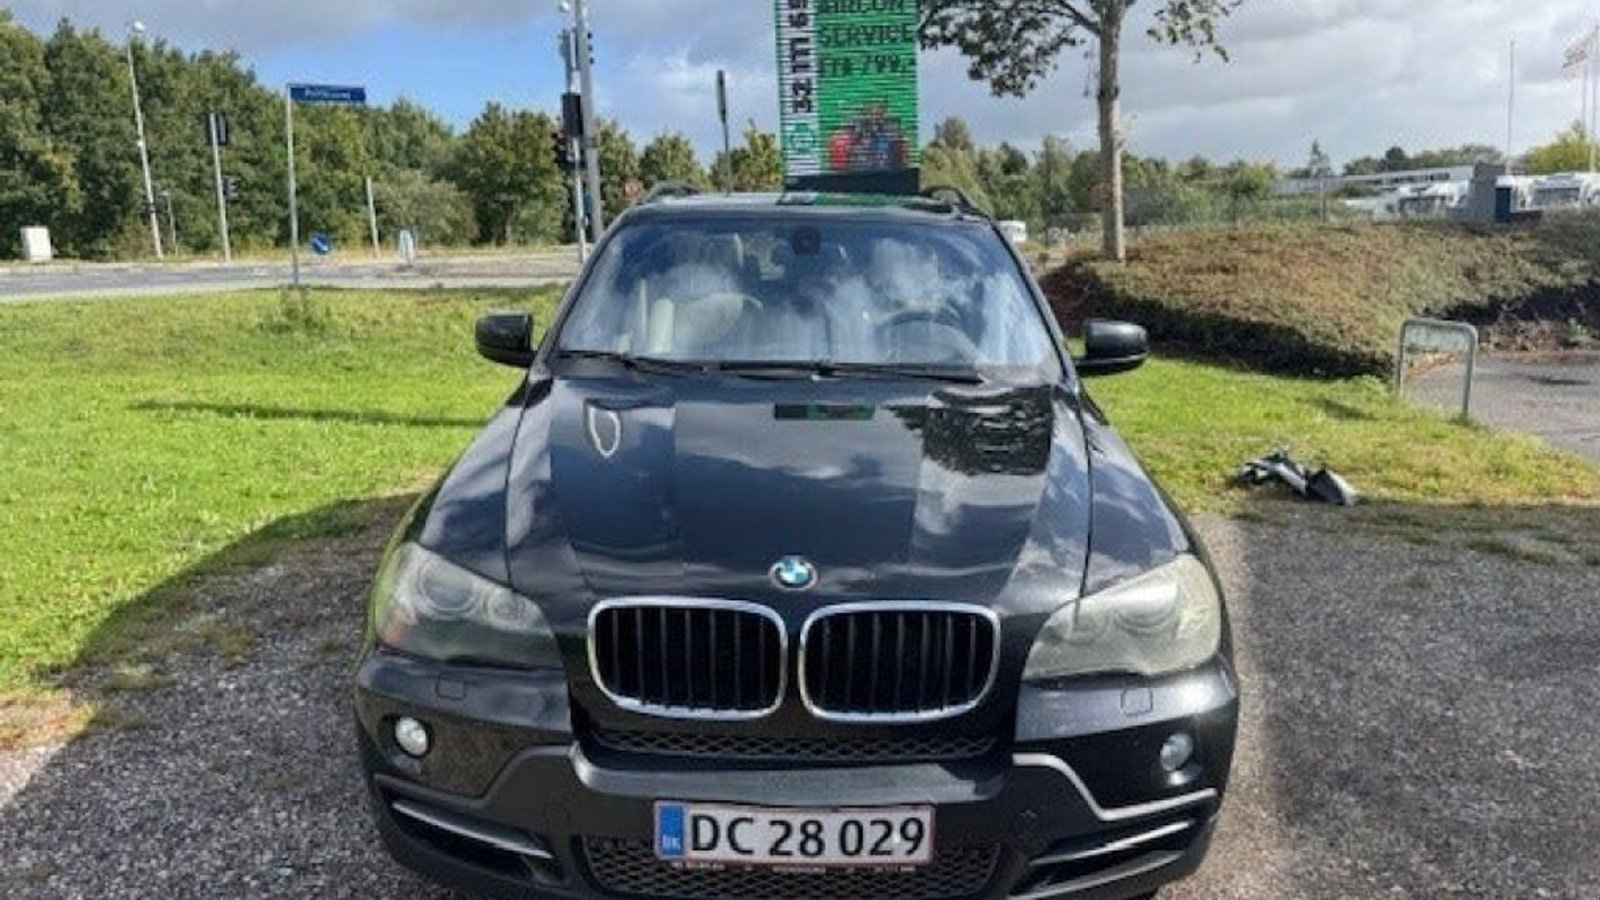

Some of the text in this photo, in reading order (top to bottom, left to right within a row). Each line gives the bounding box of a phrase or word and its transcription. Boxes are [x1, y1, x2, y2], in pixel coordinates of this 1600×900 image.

[819, 23, 914, 47] SERVICE
[691, 815, 924, 857] DC 28 029
